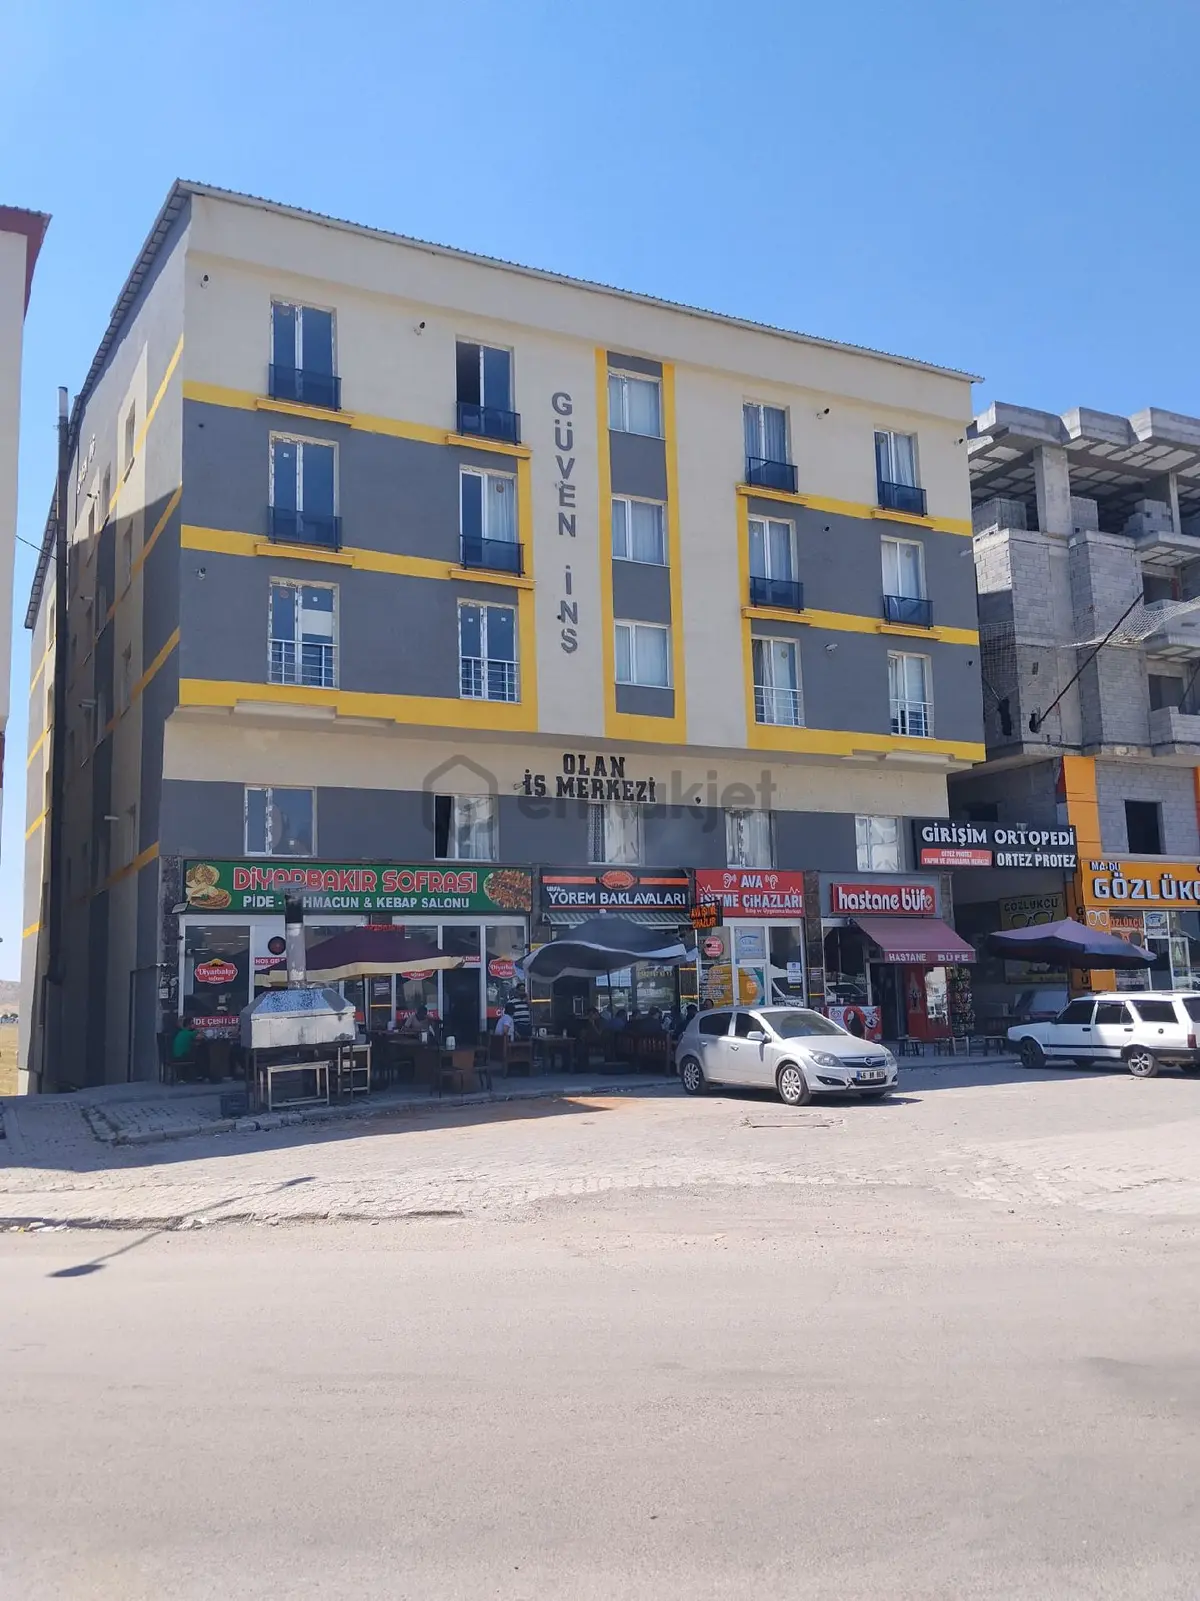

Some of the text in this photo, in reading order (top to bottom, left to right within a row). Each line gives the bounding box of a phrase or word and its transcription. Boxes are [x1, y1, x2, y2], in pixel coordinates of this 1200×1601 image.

[552, 392, 576, 538] GÜVEN
[563, 753, 625, 777] OLAN
[556, 776, 656, 802] MERKEZİ
[922, 823, 1074, 846] GİRİŞİM ORTOPEDİ
[997, 853, 1076, 867] ORTEZ PROTEZ
[382, 869, 477, 893] SOFRASI
[740, 875, 763, 888] AVA
[243, 894, 274, 907] PİDE
[303, 896, 359, 908] HMACUN
[364, 897, 373, 908] &
[376, 898, 417, 908] KEBAP
[421, 898, 469, 908] SALONU
[549, 889, 686, 904] YÖREM BAKLAVALARI
[838, 886, 933, 911] hastane büfe
[889, 952, 969, 962] HASTANE BÜFE
